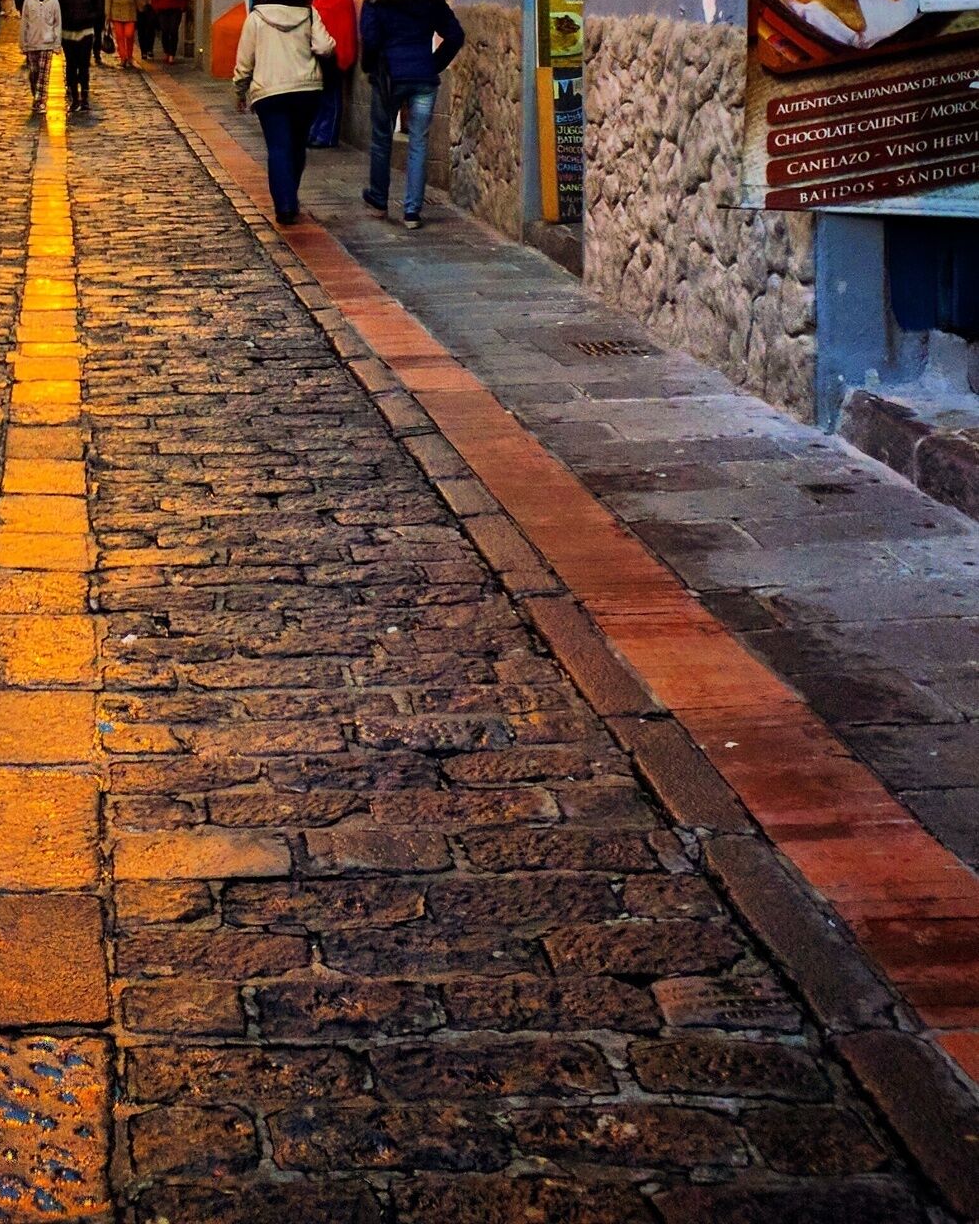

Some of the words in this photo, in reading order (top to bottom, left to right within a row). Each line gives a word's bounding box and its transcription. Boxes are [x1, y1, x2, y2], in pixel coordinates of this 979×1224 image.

[850, 80, 920, 102] EMPANADAS
[922, 77, 939, 89] DE
[774, 123, 855, 147] CHOCOLATE
[857, 111, 919, 133] CALIENTE
[786, 150, 870, 175] CANELAZO
[886, 140, 928, 158] VINO
[799, 180, 875, 204] BATIDOS
